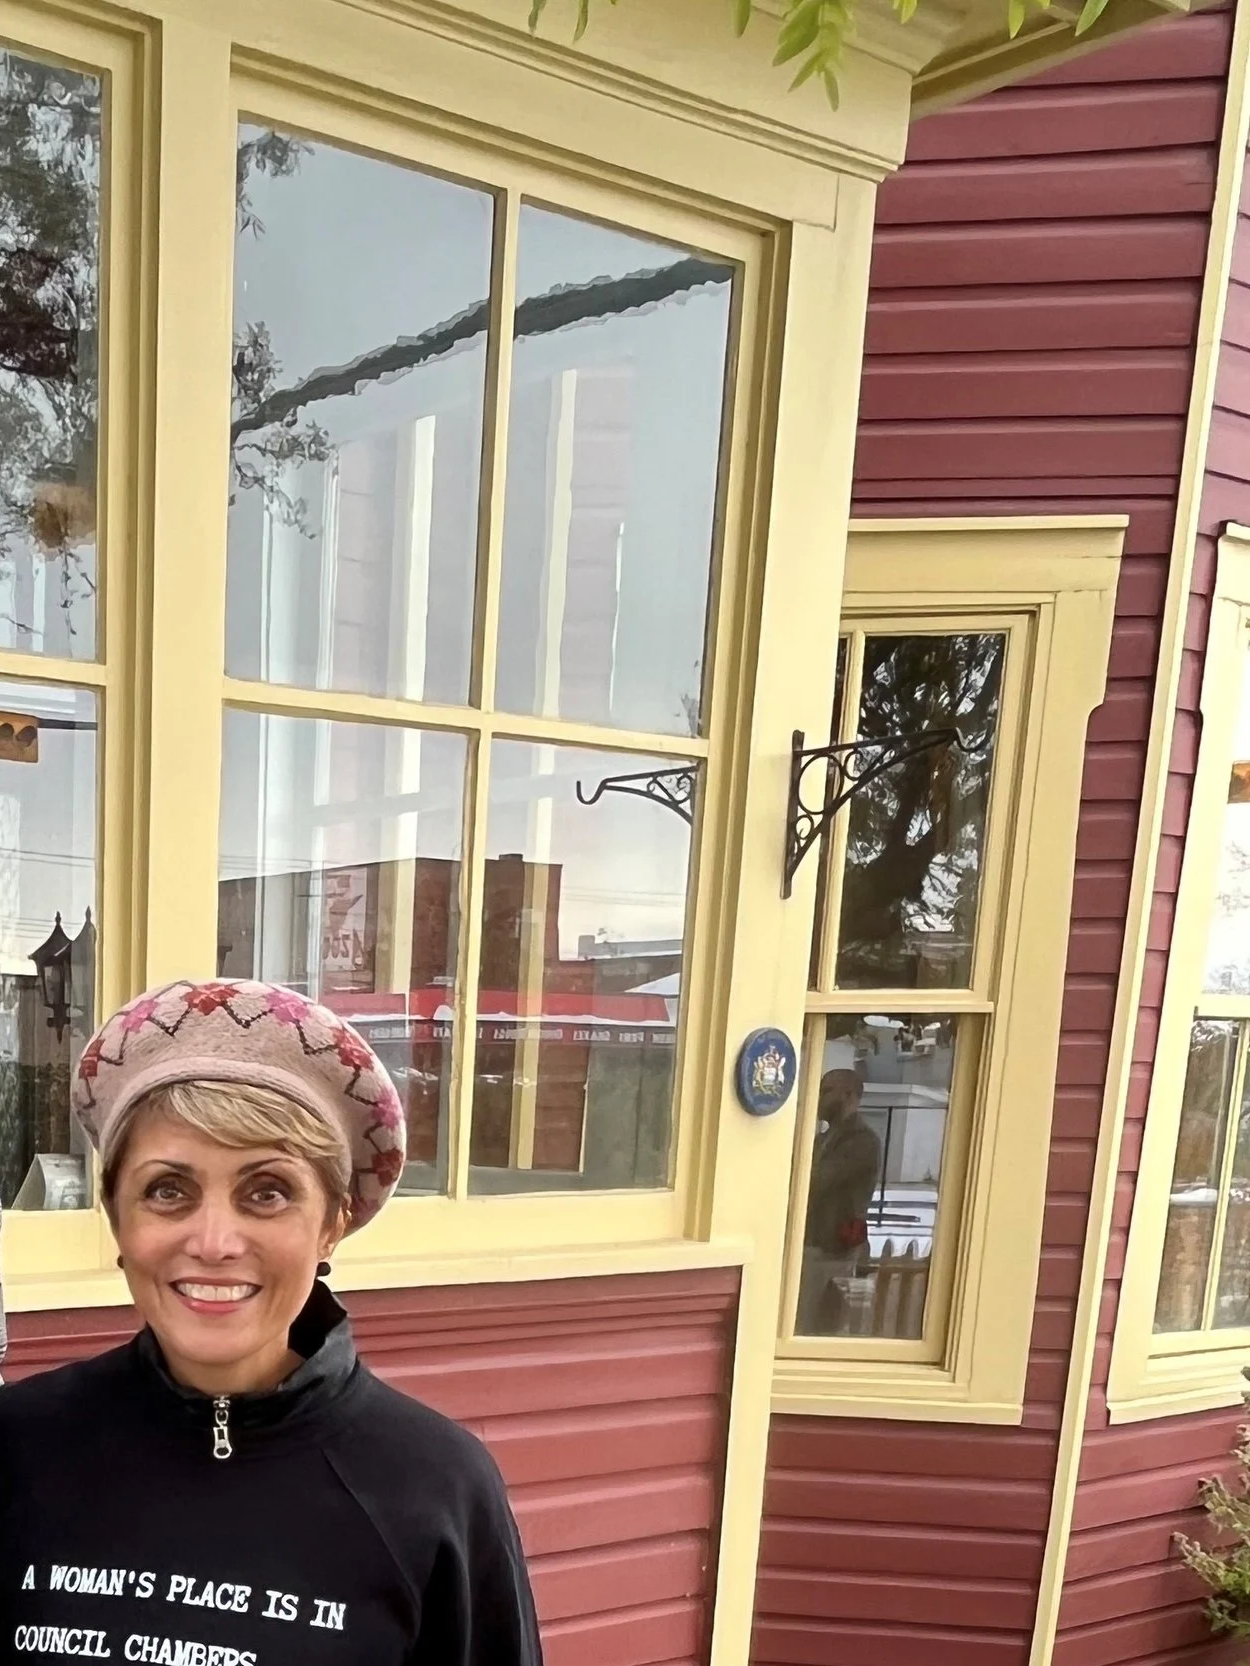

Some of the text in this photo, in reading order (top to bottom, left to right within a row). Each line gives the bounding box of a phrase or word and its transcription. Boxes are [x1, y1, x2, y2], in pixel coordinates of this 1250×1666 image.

[21, 1564, 347, 1631] A WOMAN'S PLACE IS IN
[14, 1624, 112, 1658] COUNCIL
